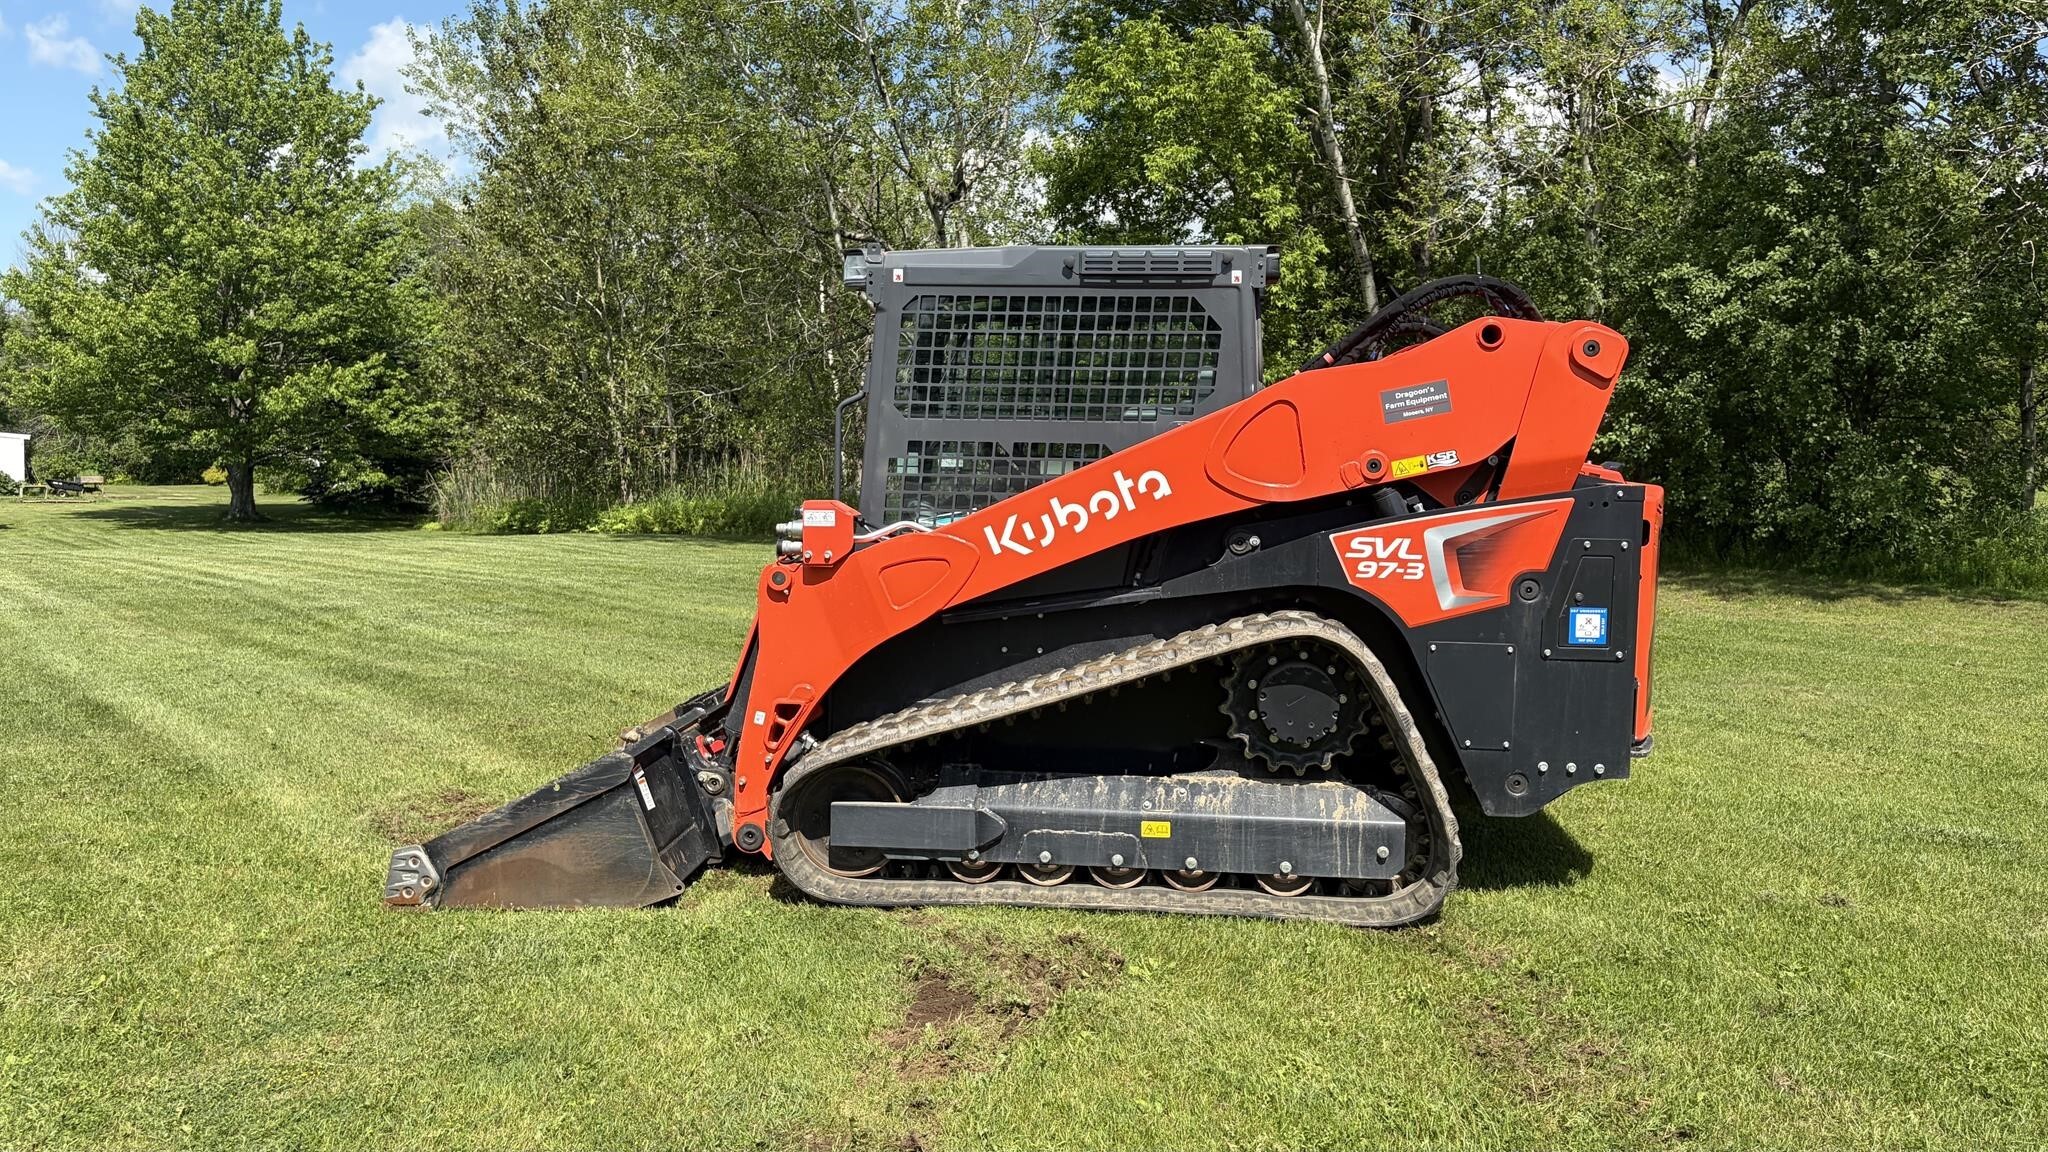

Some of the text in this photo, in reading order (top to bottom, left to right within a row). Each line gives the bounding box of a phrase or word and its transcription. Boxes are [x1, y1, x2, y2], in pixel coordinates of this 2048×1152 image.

[1385, 392, 1448, 410] Farm Equipment
[1395, 387, 1434, 399] Dragoon's
[1426, 450, 1457, 464] KSR
[983, 469, 1172, 556] Kubota
[1345, 536, 1424, 560] SVL
[1355, 561, 1426, 580] 97-3
